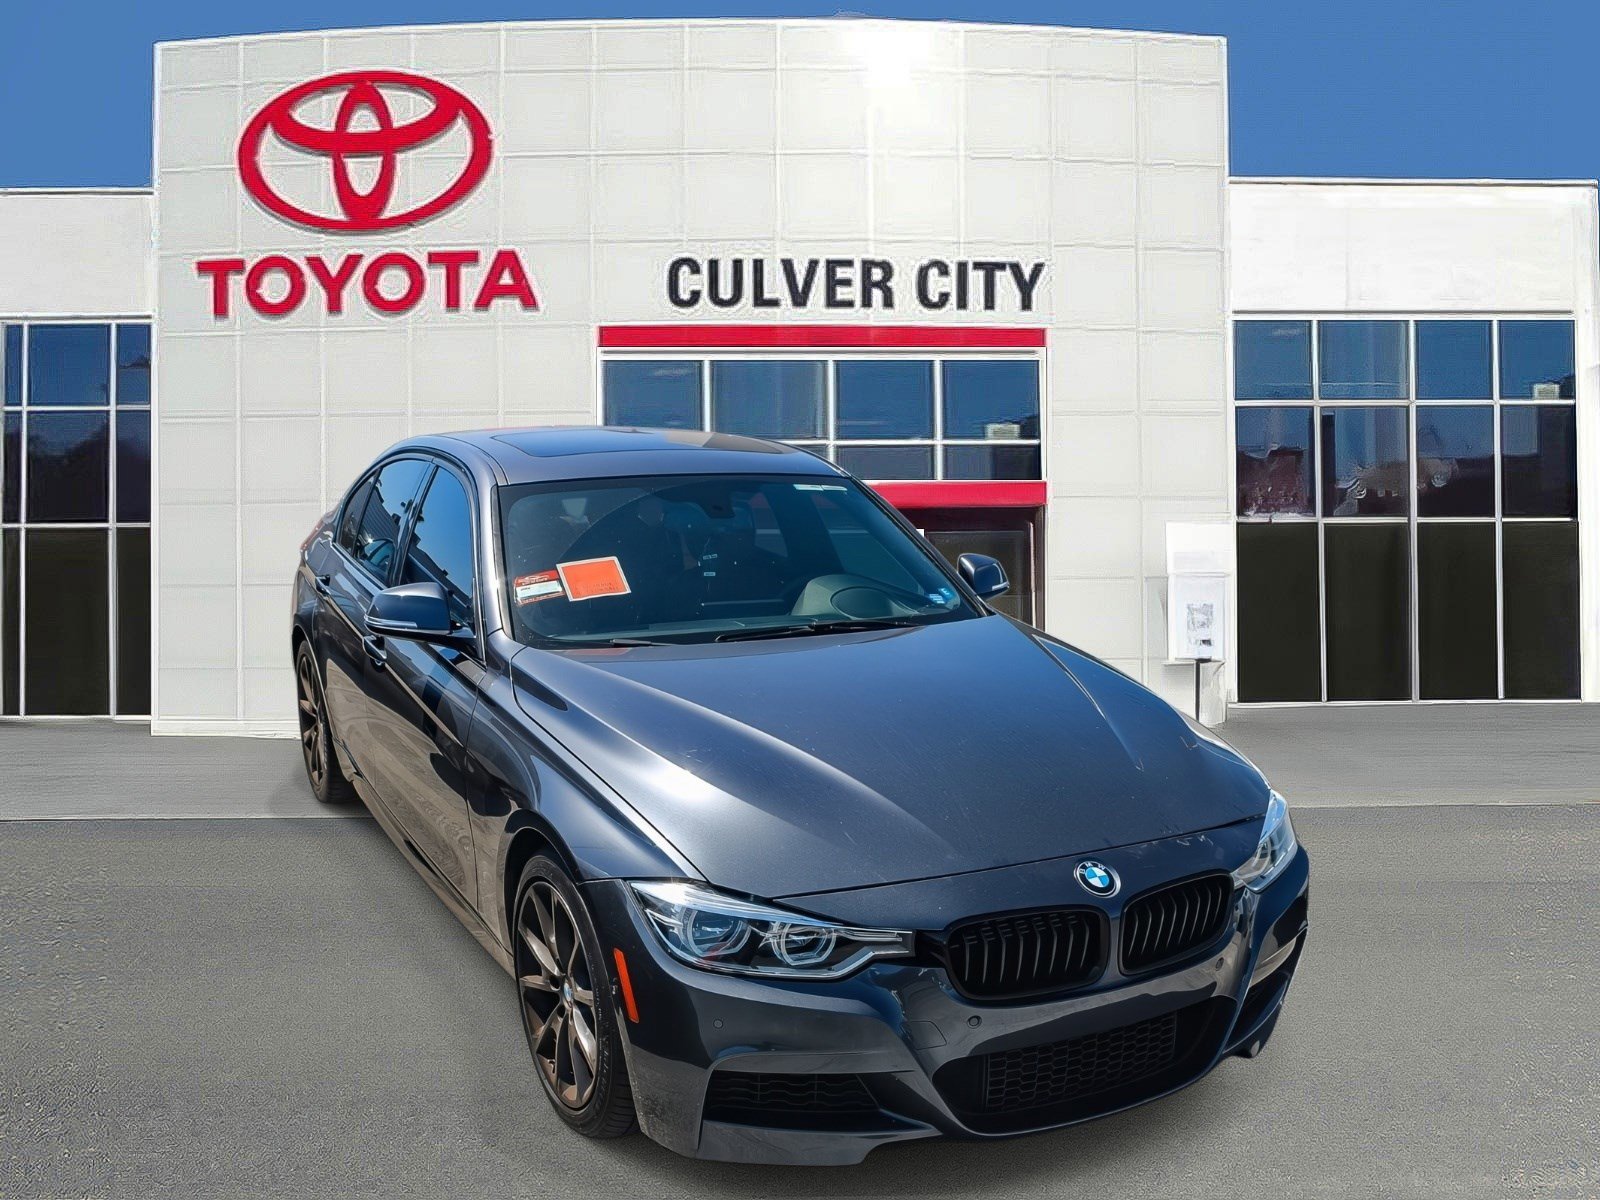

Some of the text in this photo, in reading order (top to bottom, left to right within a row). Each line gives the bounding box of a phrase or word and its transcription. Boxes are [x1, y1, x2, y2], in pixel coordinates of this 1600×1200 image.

[196, 249, 538, 317] TOYOTA
[668, 257, 1045, 311] CULVER CITY
